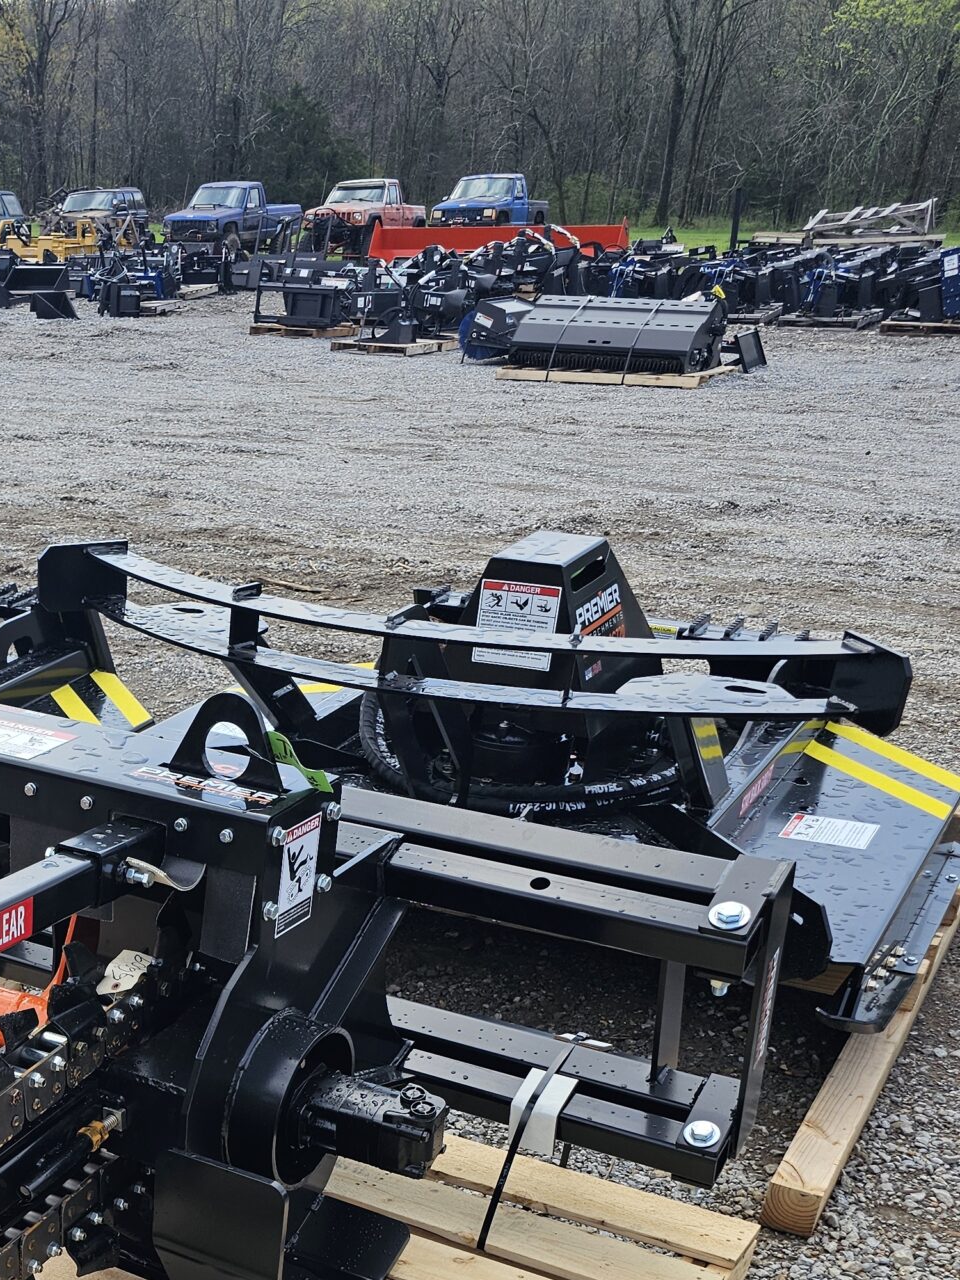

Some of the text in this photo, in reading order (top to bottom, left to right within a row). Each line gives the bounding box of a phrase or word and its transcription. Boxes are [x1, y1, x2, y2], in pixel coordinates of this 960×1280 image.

[509, 584, 541, 595] DANGER
[575, 583, 621, 626] PREMIER
[136, 766, 280, 801] PREMIER
[293, 818, 320, 839] DANGER
